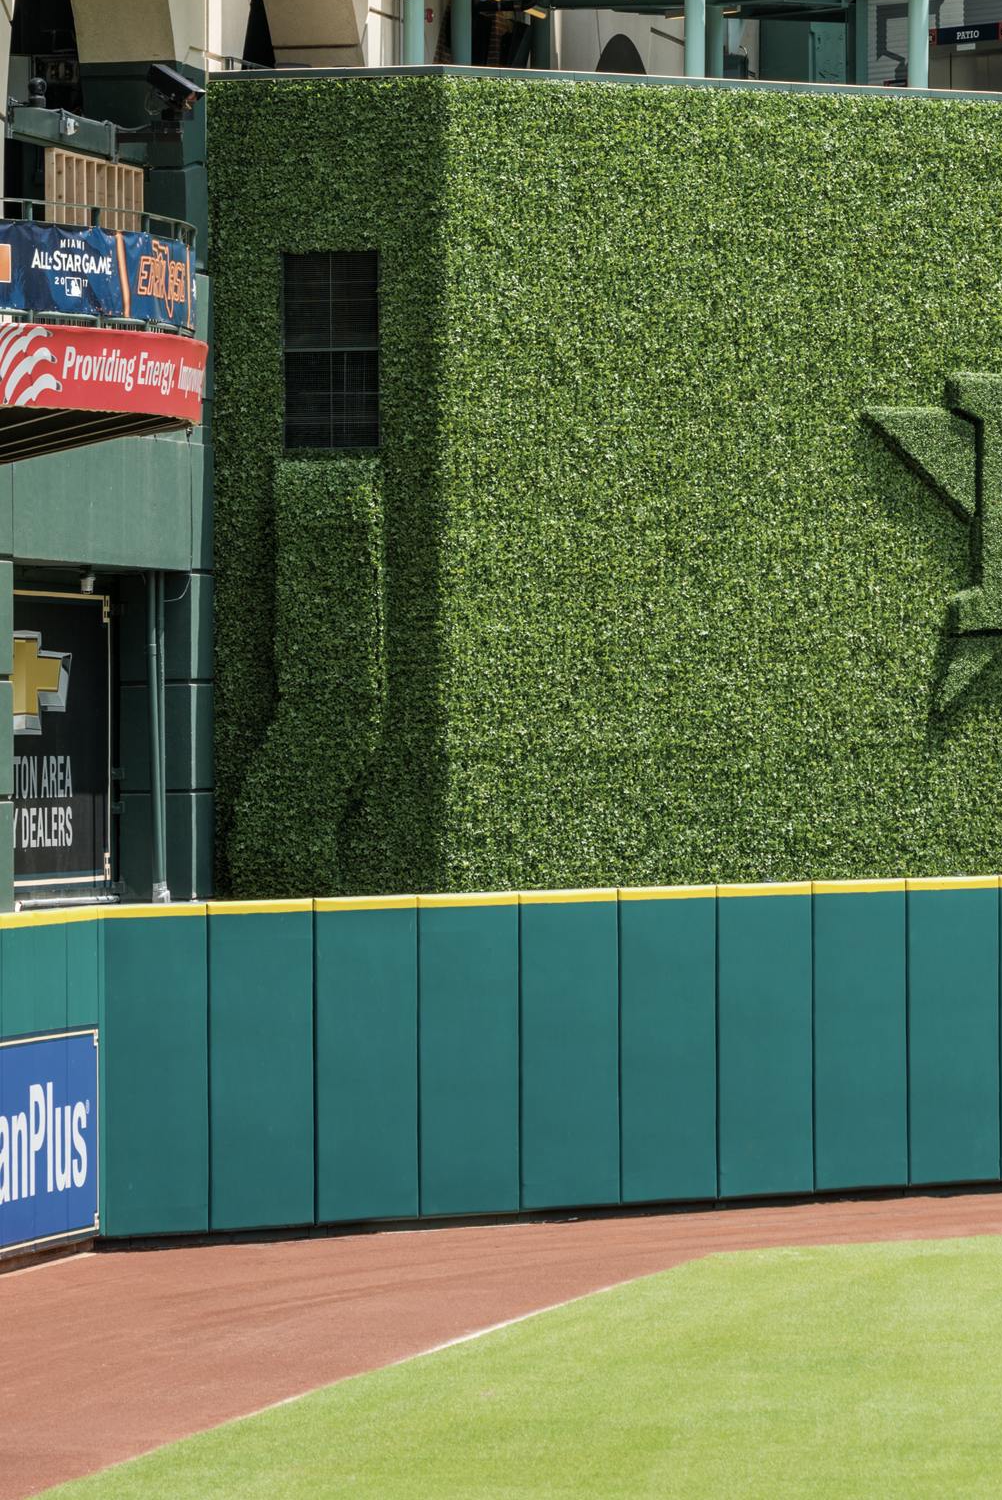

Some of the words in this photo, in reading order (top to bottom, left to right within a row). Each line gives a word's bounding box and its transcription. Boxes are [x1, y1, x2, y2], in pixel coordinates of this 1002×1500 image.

[956, 30, 980, 40] PATIO
[60, 239, 85, 250] MIAMI
[62, 346, 137, 392] Providing
[137, 352, 176, 396] Energy.
[41, 755, 73, 798] AREA
[21, 806, 73, 848] DEALERS
